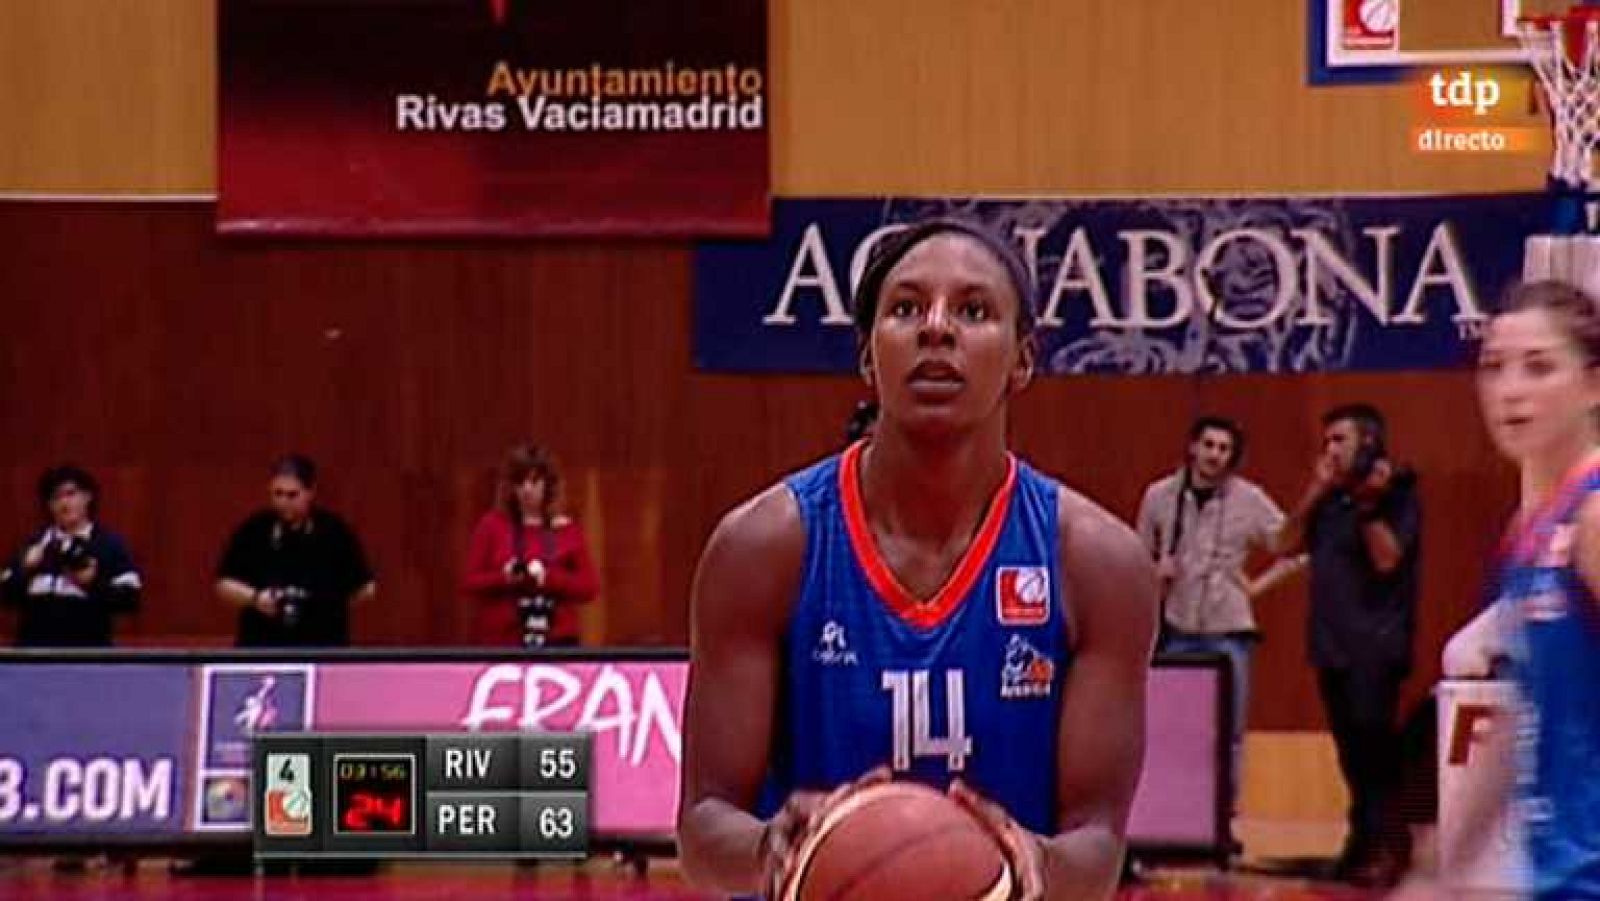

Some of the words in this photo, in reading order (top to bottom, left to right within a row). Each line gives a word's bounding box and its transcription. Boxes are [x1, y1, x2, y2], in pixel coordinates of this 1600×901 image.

[486, 61, 763, 97] Ayuntamiento
[397, 95, 506, 130] Rivas
[518, 95, 763, 130] Vaciamadrid
[881, 668, 972, 771] 14
